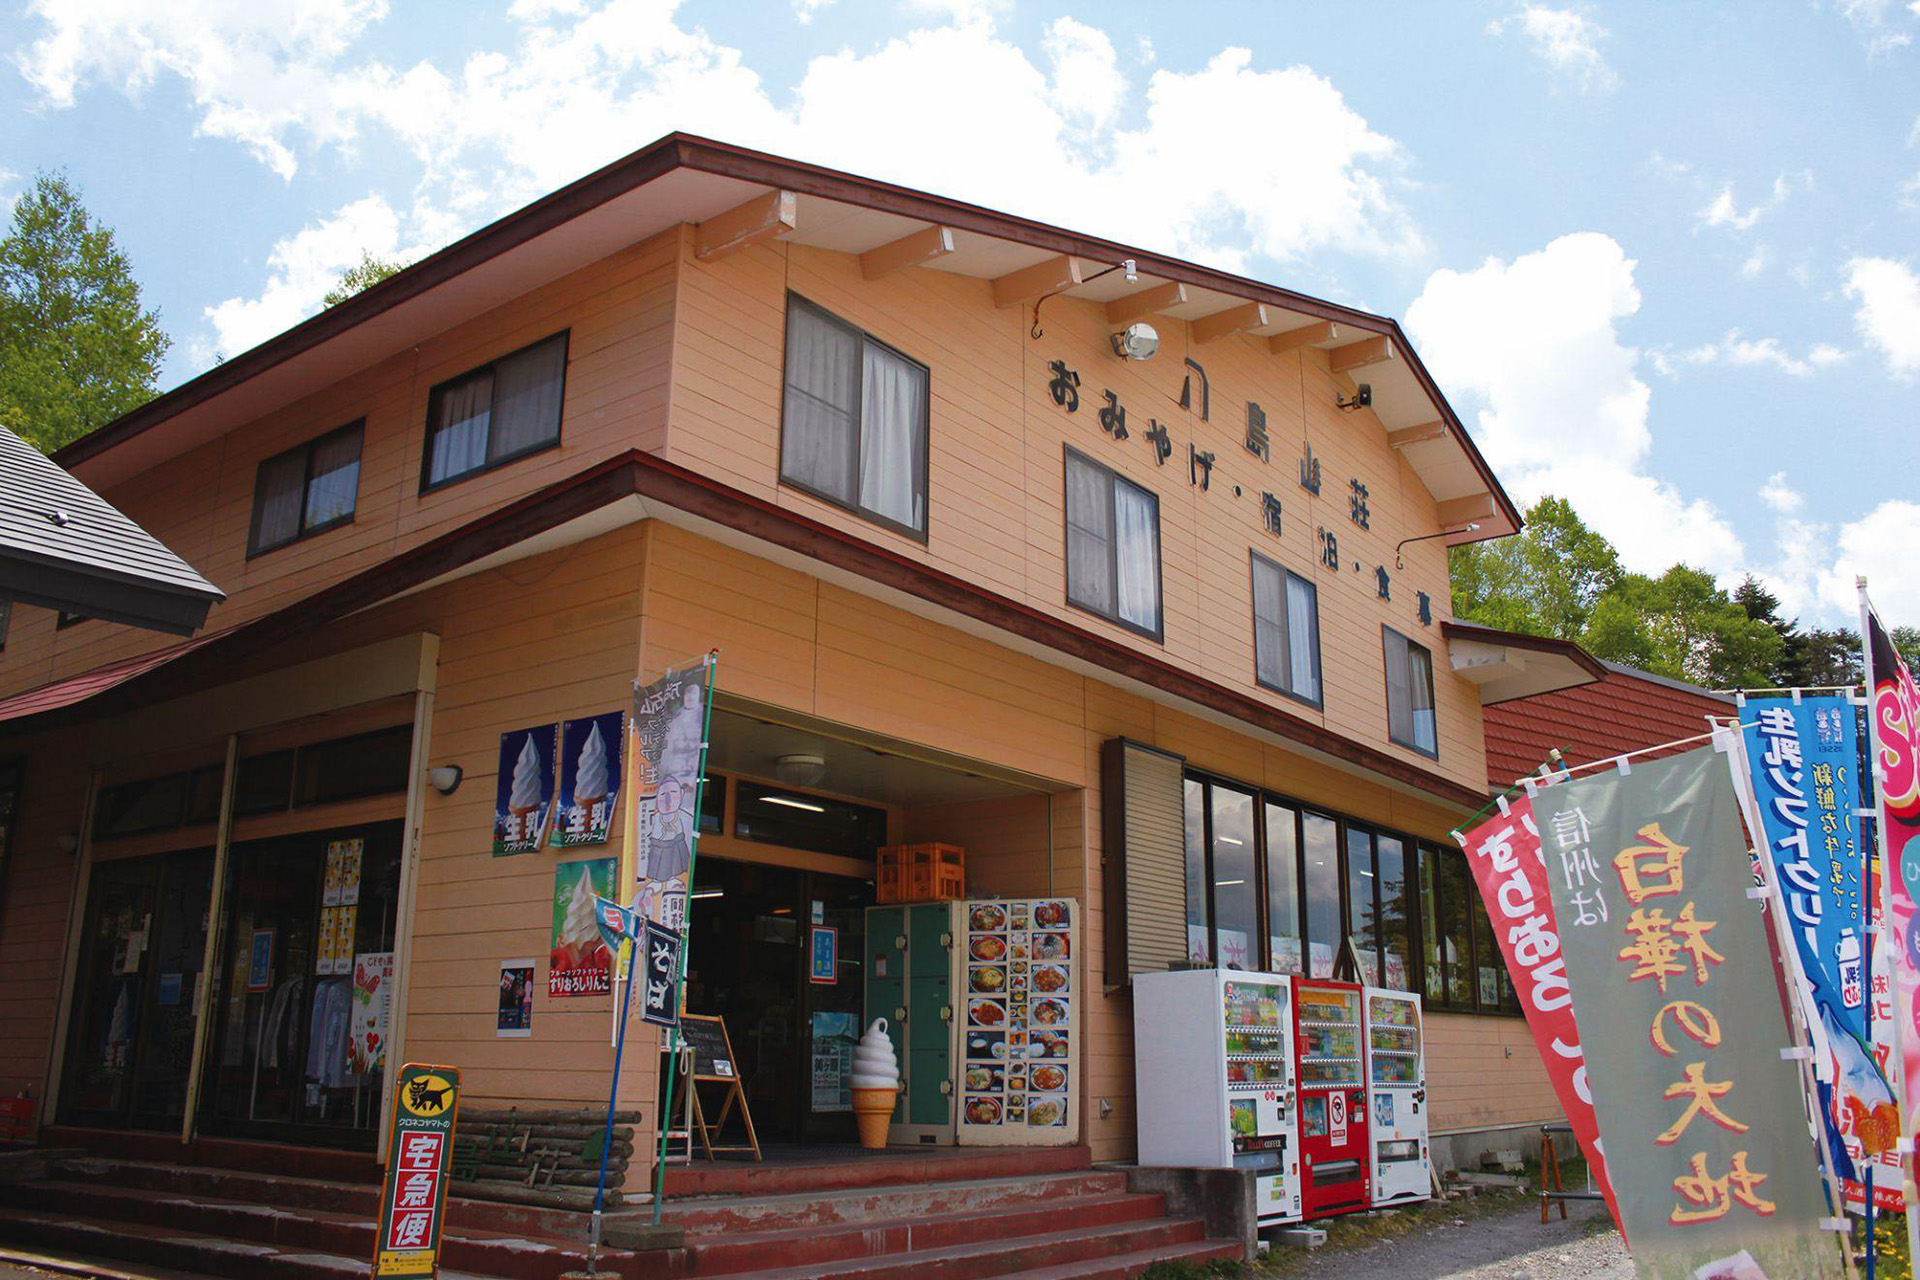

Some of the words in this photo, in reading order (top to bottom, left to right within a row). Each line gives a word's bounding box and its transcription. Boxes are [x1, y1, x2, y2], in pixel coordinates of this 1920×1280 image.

[505, 809, 541, 841] 生乳
[566, 802, 607, 832] 生乳
[504, 840, 534, 852] ソフトクリー
[550, 974, 610, 993] すりおろしりんご
[399, 1117, 451, 1128] クロネコヤマトの
[395, 1135, 439, 1247] 宅急便
